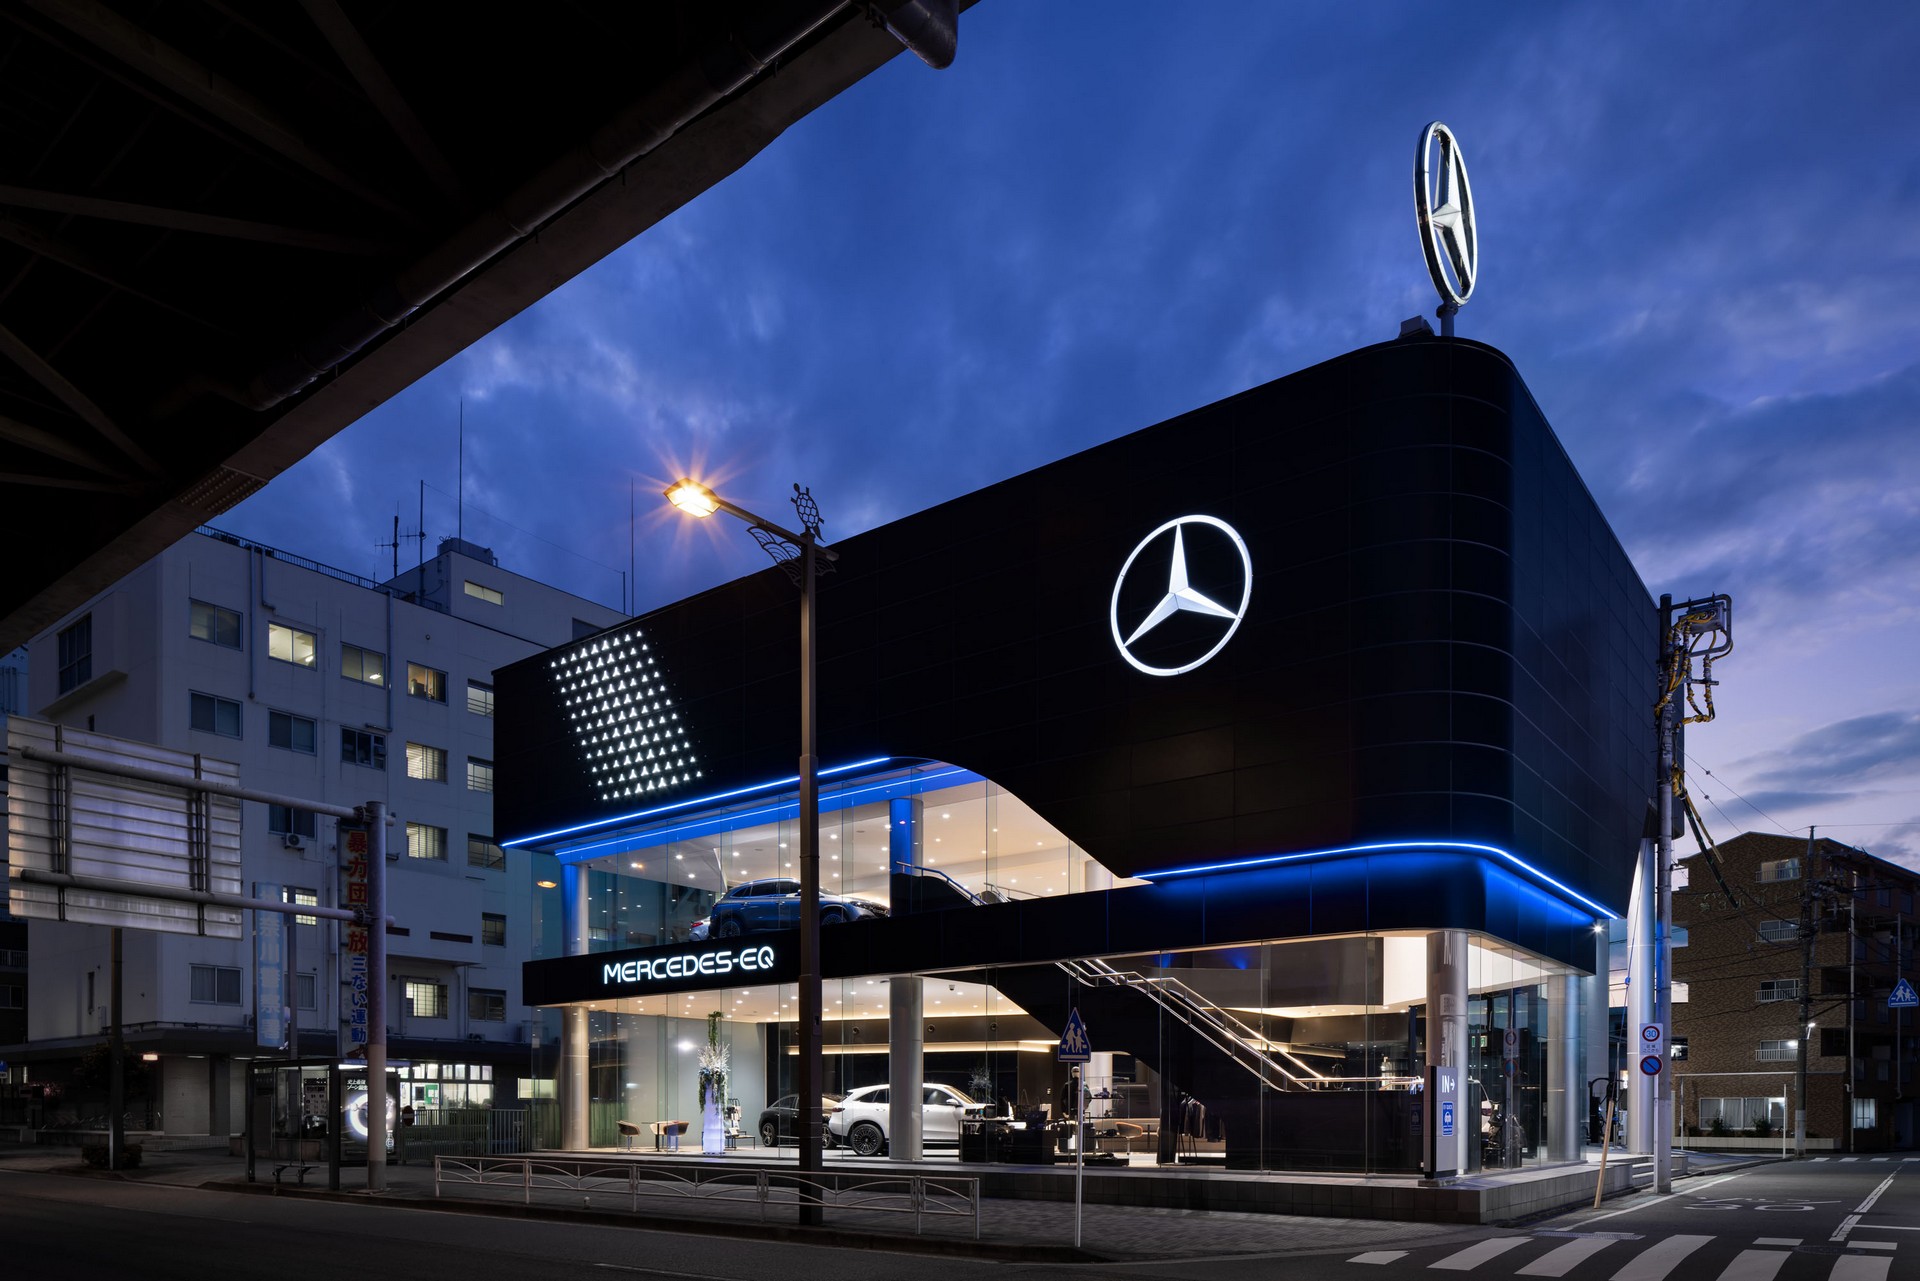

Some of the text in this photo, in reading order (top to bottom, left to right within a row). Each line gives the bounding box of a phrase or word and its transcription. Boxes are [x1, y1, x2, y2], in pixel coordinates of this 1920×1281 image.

[348, 831, 368, 953] 暴力団放
[603, 945, 775, 985] MERCEDES-EQ
[1646, 1030, 1657, 1038] 30
[1441, 1075, 1450, 1093] IN
[1683, 1203, 1816, 1212] 30
